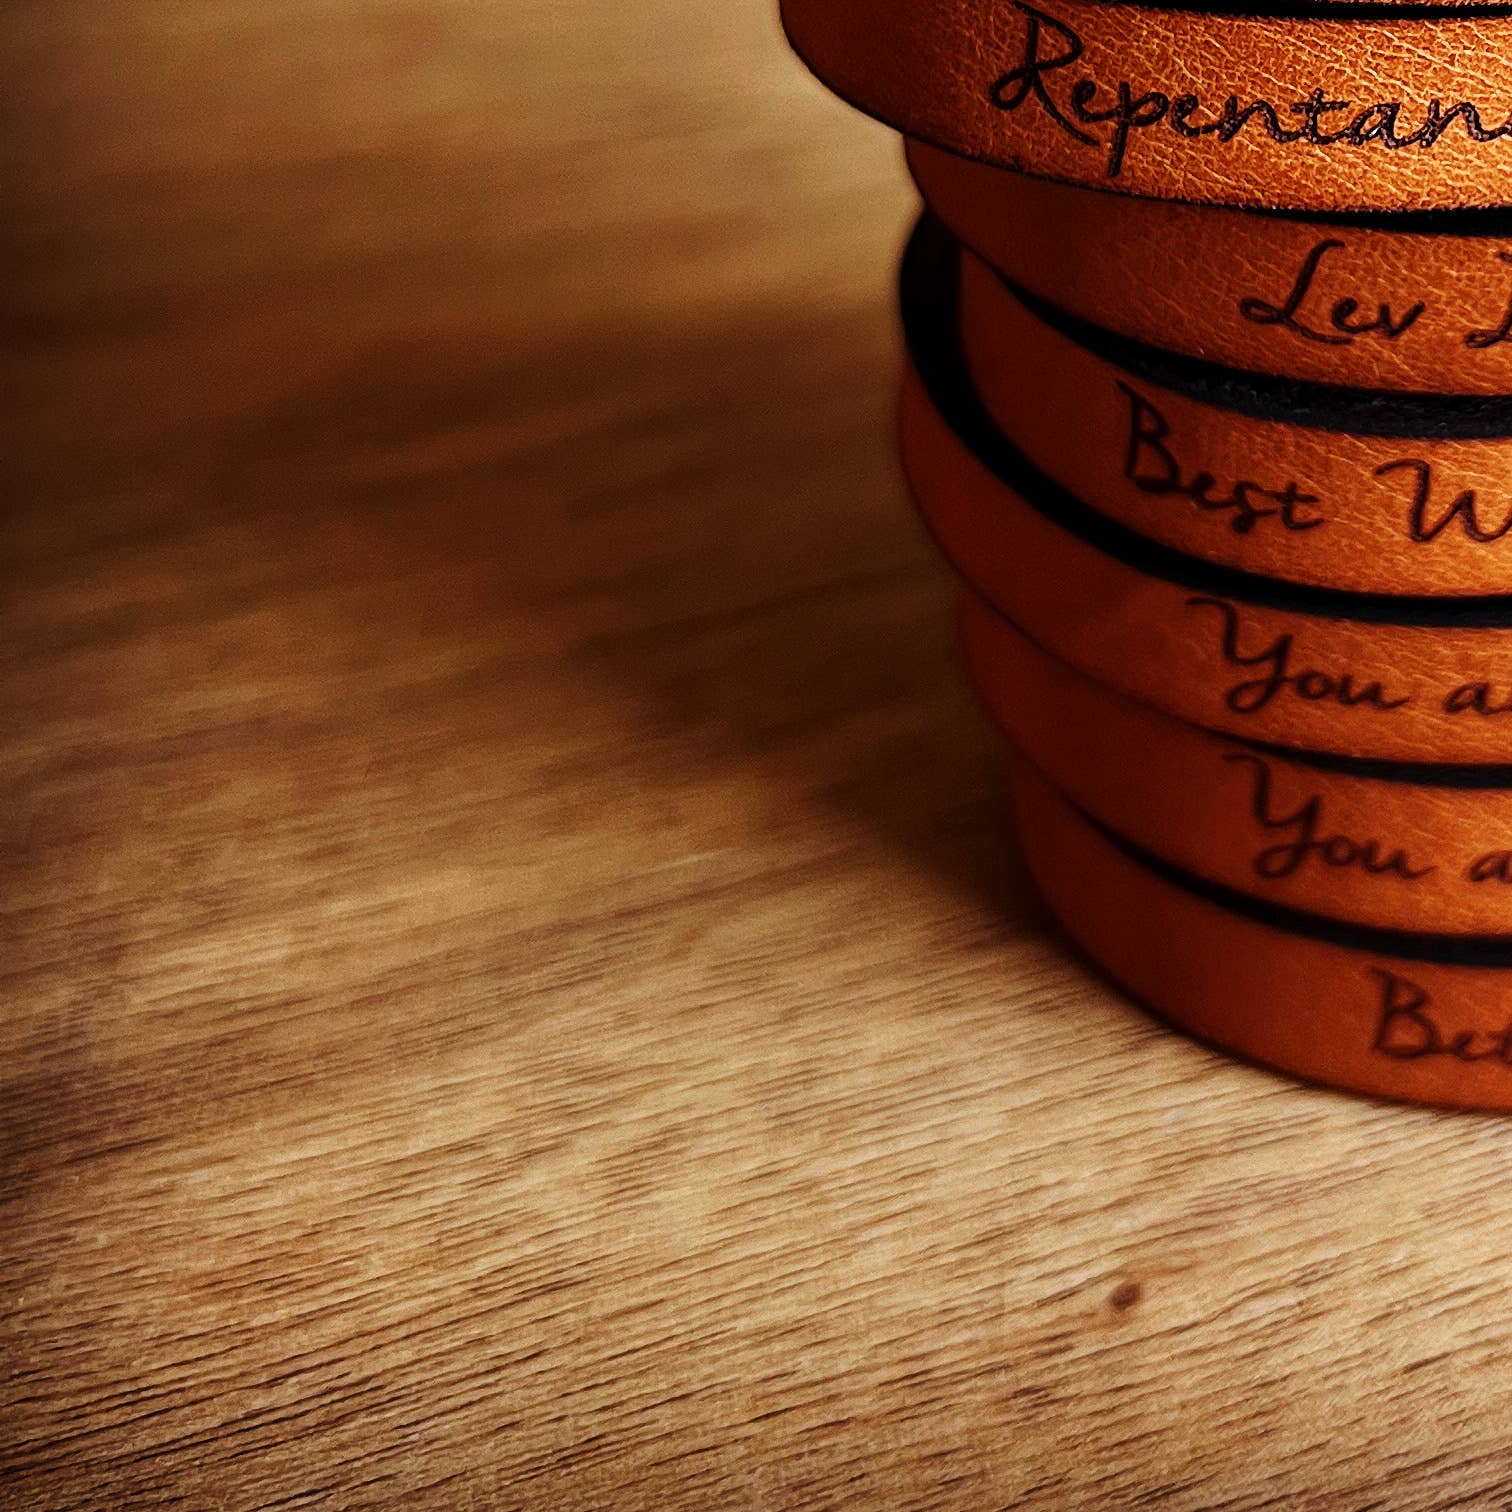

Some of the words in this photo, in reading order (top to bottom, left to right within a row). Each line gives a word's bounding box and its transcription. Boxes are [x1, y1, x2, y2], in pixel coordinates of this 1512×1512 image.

[1240, 240, 1428, 346] Lev
[1116, 380, 1325, 532] Best
[1186, 596, 1409, 713] You
[1220, 753, 1437, 879] You
